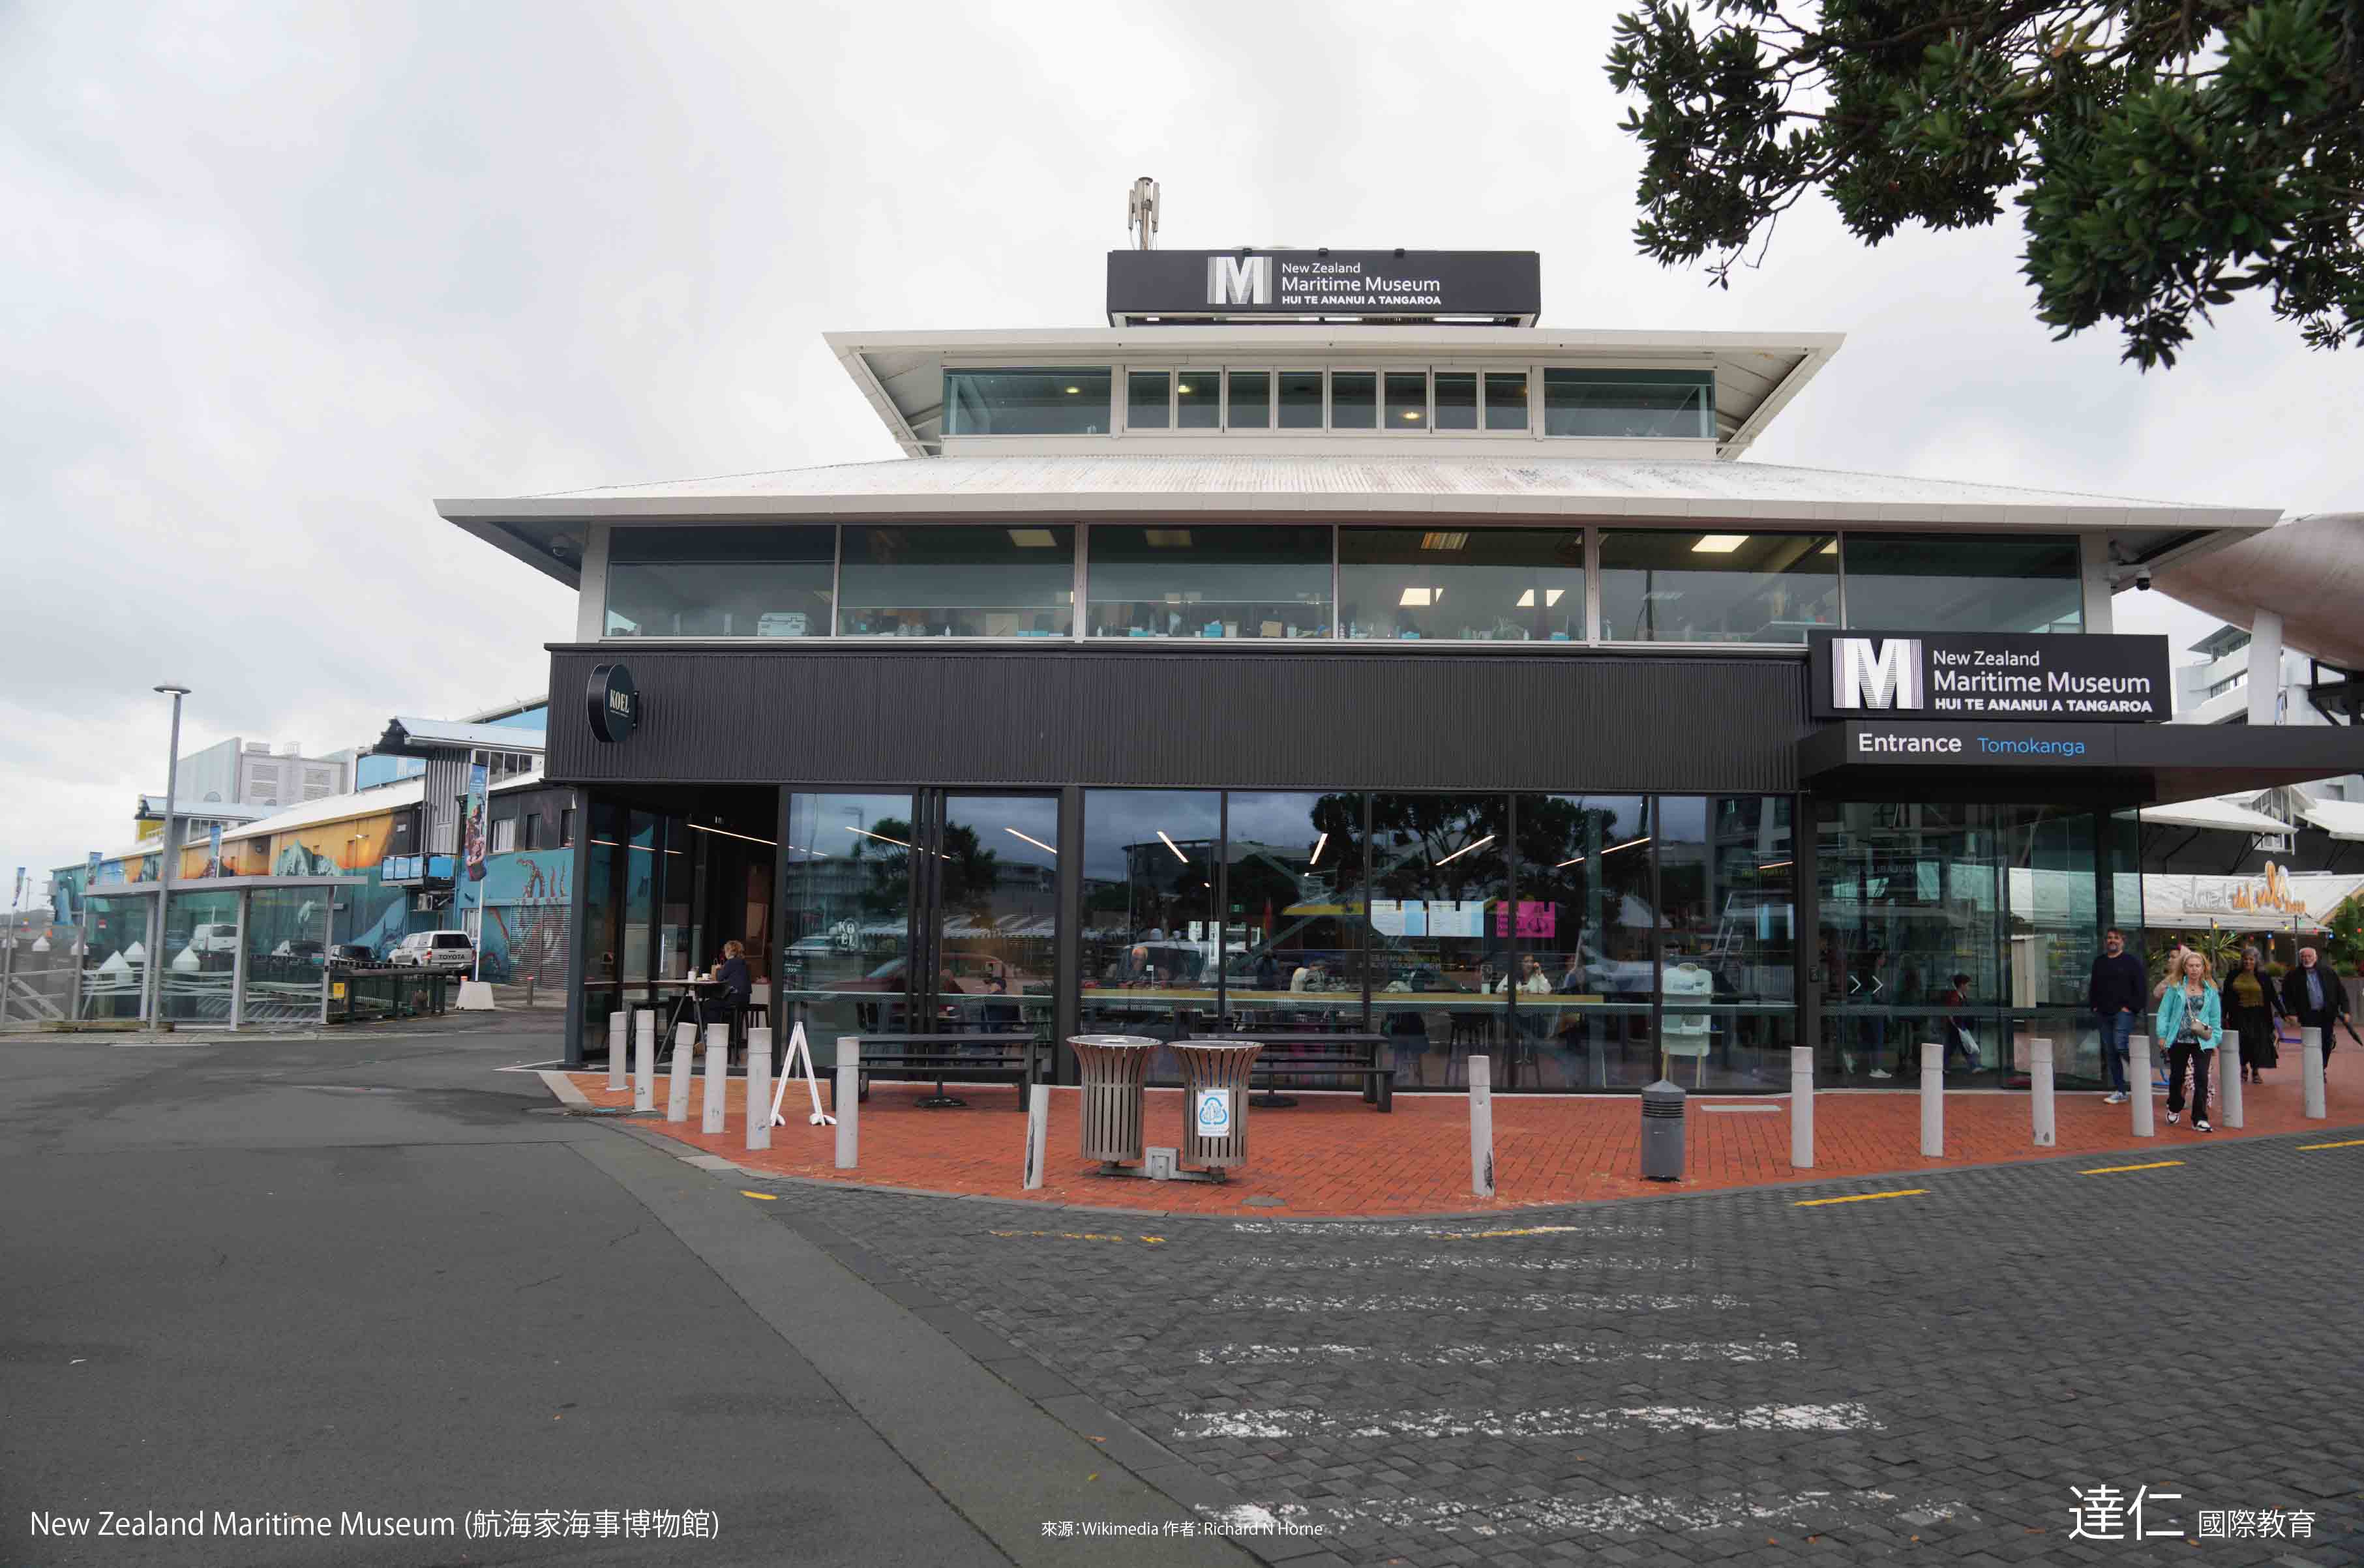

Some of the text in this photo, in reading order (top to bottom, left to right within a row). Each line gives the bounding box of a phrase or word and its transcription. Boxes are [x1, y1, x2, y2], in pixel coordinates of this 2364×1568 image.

[1281, 262, 1361, 274] New Zealand
[1207, 256, 1272, 304] M
[1281, 276, 1441, 292] Maritime Museum
[1281, 295, 1443, 305] HUI TE ANANUI A TANGAROA
[1934, 650, 2041, 666] New Zealand
[1833, 638, 1924, 710] M
[1934, 670, 2151, 694] Maritime Museum
[610, 689, 630, 714] KOEL
[1935, 698, 2153, 713] HUI TE ANANUI A TANGAROA
[1859, 733, 2086, 756] Entrance Tomokanga
